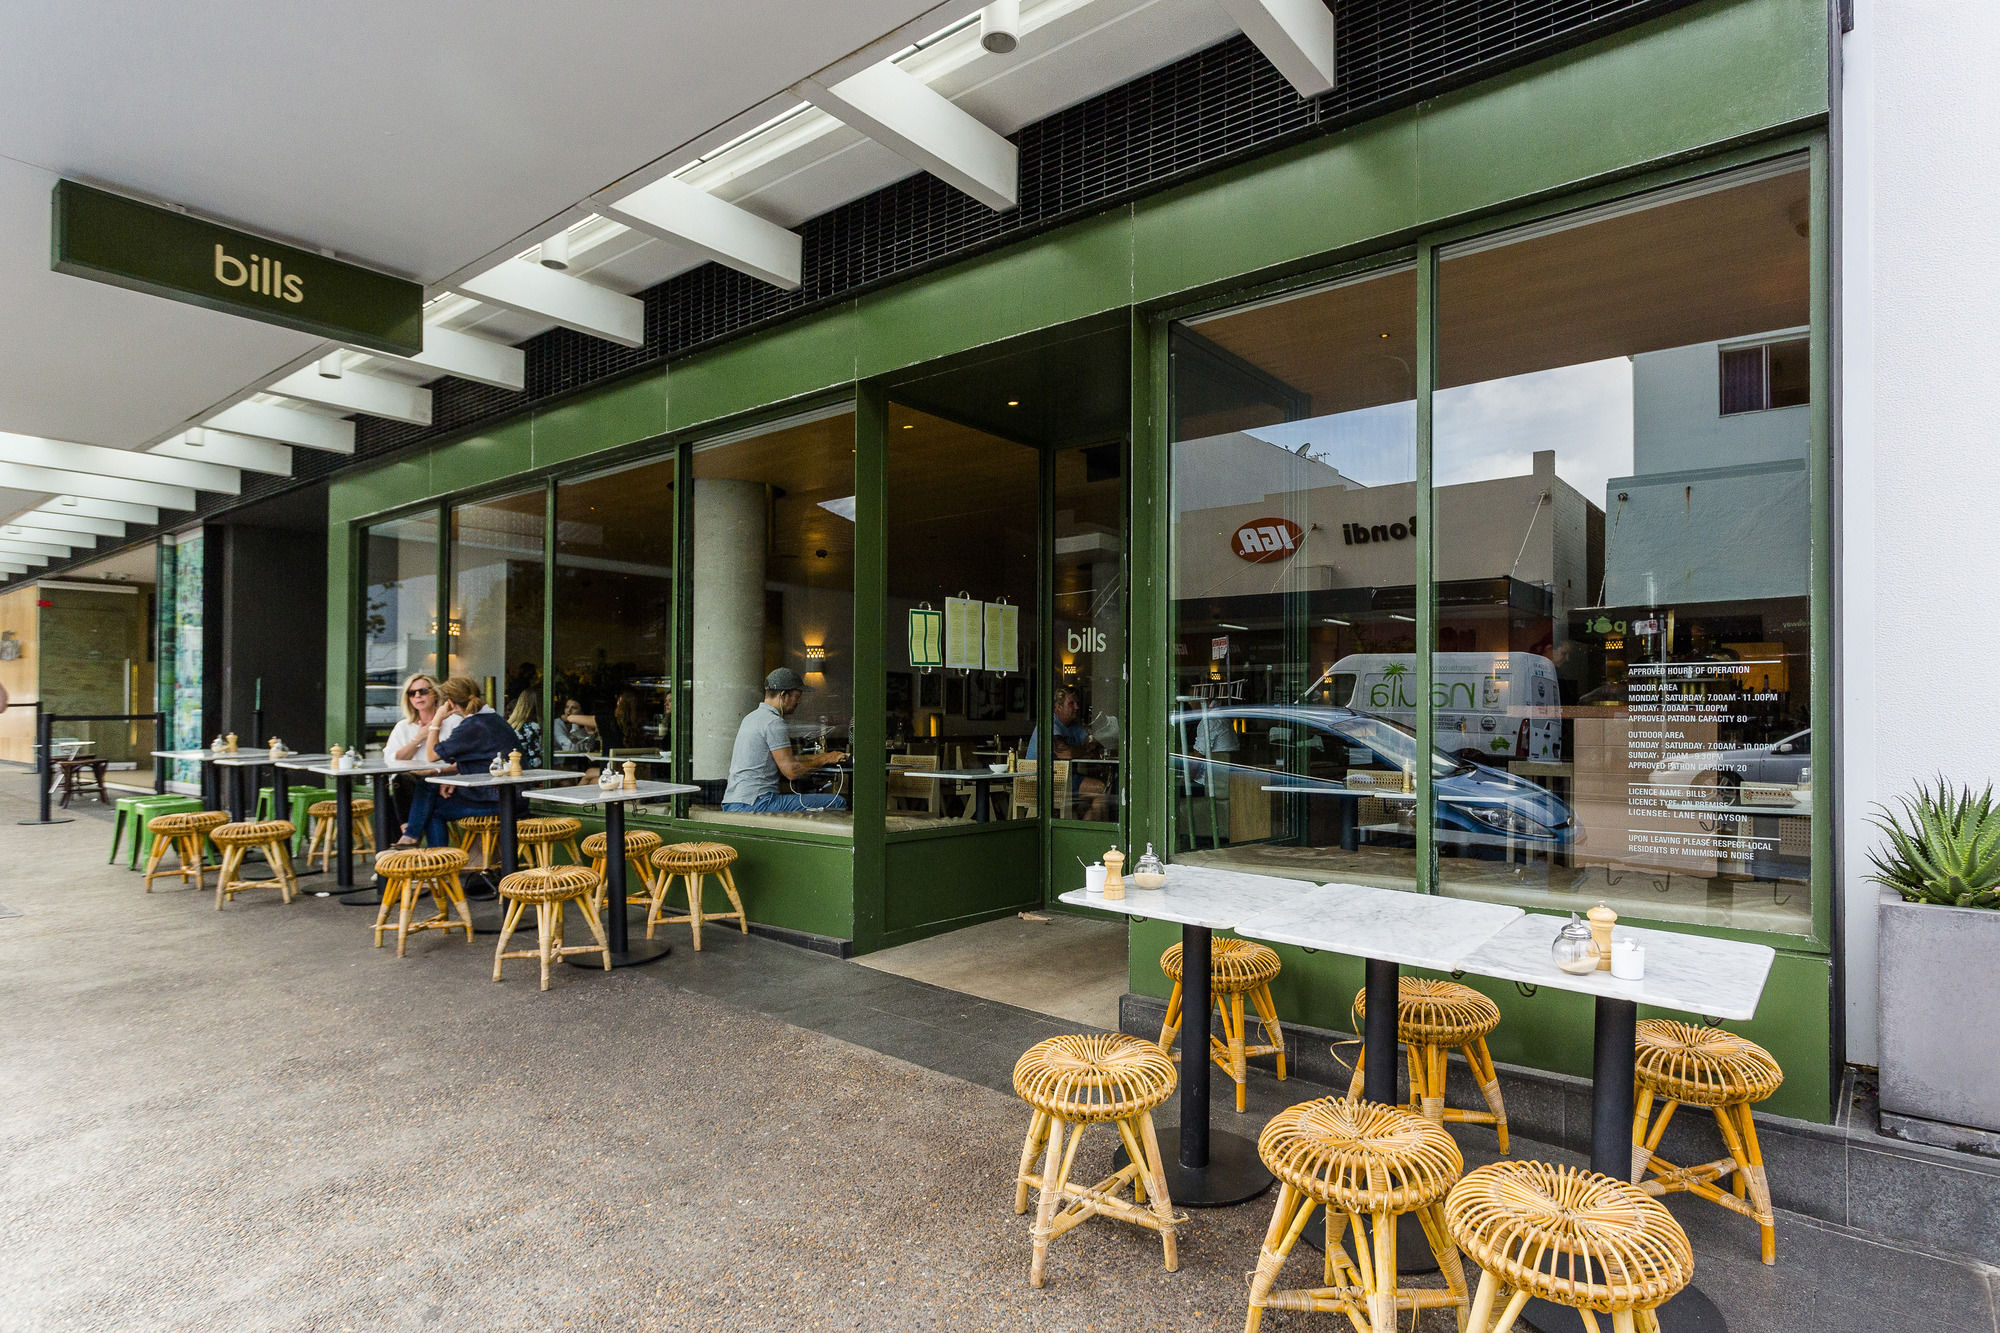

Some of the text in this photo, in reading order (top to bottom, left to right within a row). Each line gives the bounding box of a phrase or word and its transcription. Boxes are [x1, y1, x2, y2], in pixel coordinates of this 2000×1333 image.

[215, 244, 303, 303] bills
[1067, 627, 1107, 654] bills
[1628, 666, 1750, 675] APPROVED HOURS OF OPERATION
[1628, 694, 1660, 702] MONDAY
[1707, 693, 1736, 701] 7.00AM
[1743, 693, 1778, 701] 11.00PM
[1662, 704, 1689, 712] 7.00AM
[1695, 704, 1728, 712] 10.00PM
[1628, 731, 1684, 739] OUTDOOR AREA
[1707, 742, 1736, 750] 7.00AM
[1743, 743, 1777, 751] 10.00PM
[1628, 761, 1748, 772] APPROVED PATRON CAPACITY 20
[1628, 788, 1658, 796] LICENCE
[1686, 790, 1707, 798] BILLS
[1628, 798, 1658, 806] LICENCE
[1628, 808, 1748, 822] LICENSEE: LANE FINLAYSON
[1628, 834, 1648, 843] UPON
[1650, 836, 1681, 845] LEAVING
[1683, 837, 1711, 846] PLEASE
[1628, 845, 1668, 854] RESIDENTS
[1681, 848, 1728, 858] MINIMISING
[1730, 851, 1755, 860] NOISE
